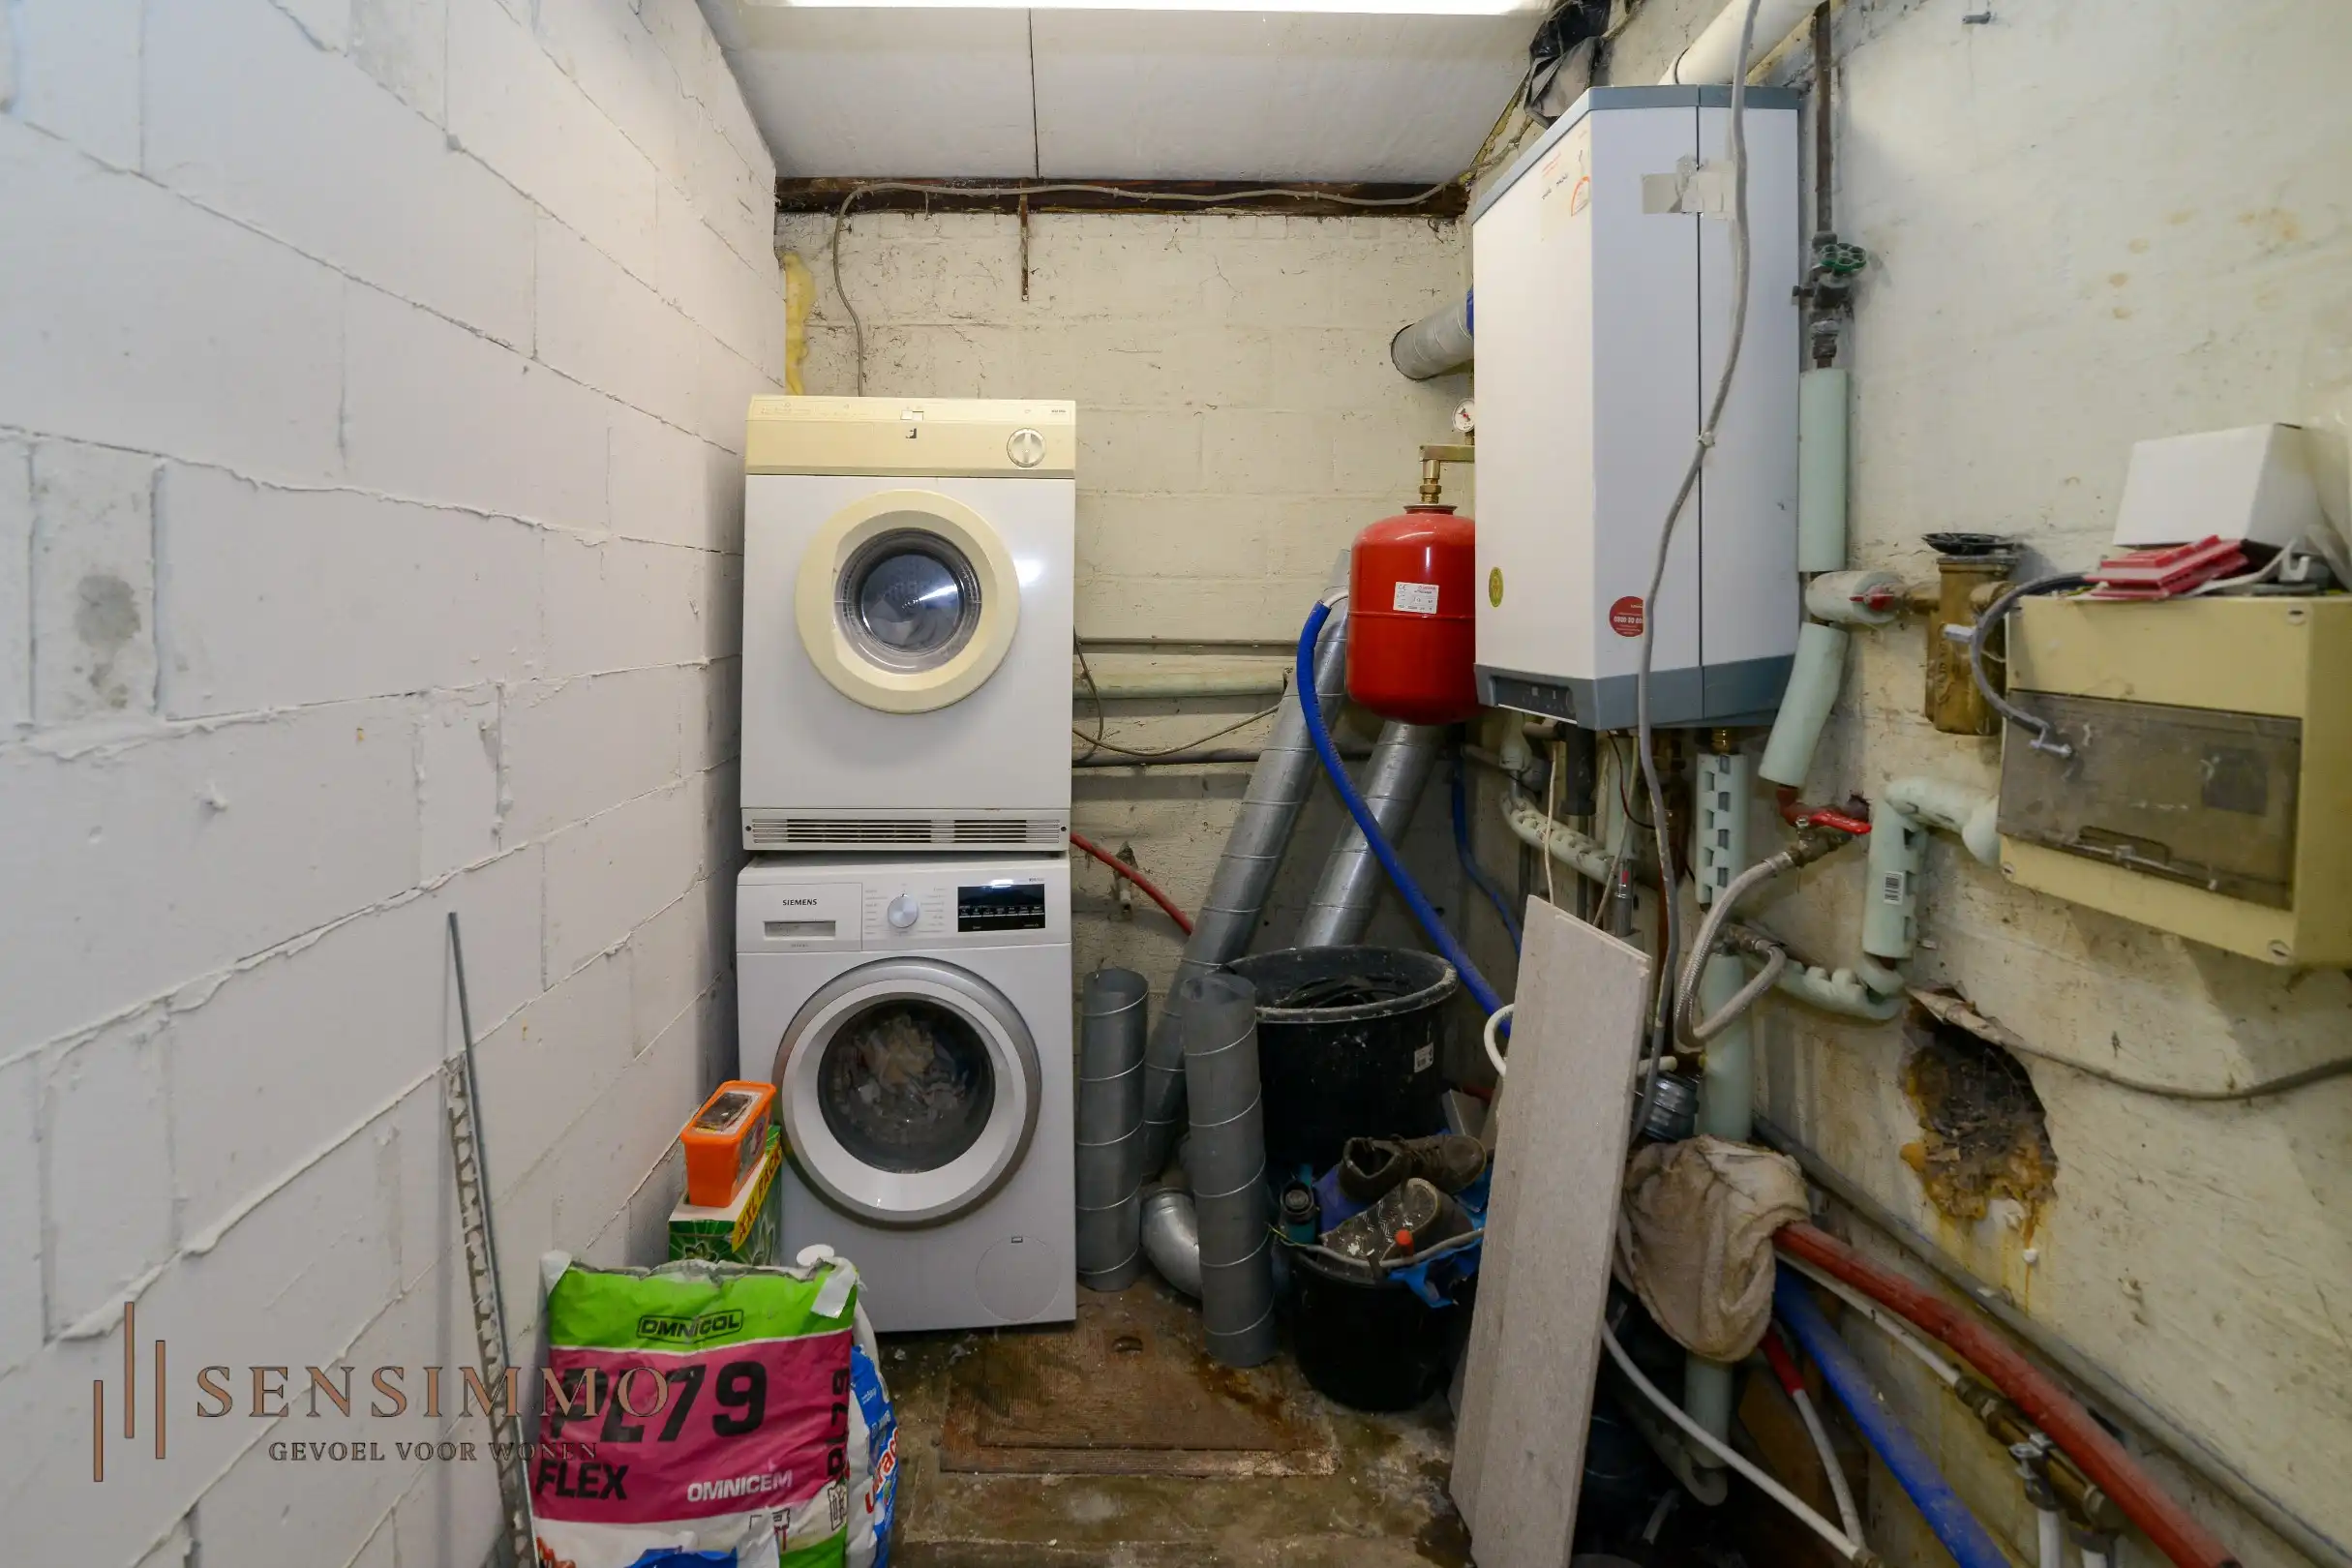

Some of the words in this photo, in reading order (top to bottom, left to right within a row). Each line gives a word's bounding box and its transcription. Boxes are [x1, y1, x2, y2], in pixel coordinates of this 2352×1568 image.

[641, 1313, 740, 1338] OMNICOL
[535, 1460, 628, 1500] FLEX
[687, 1469, 793, 1502] OMNICEM
